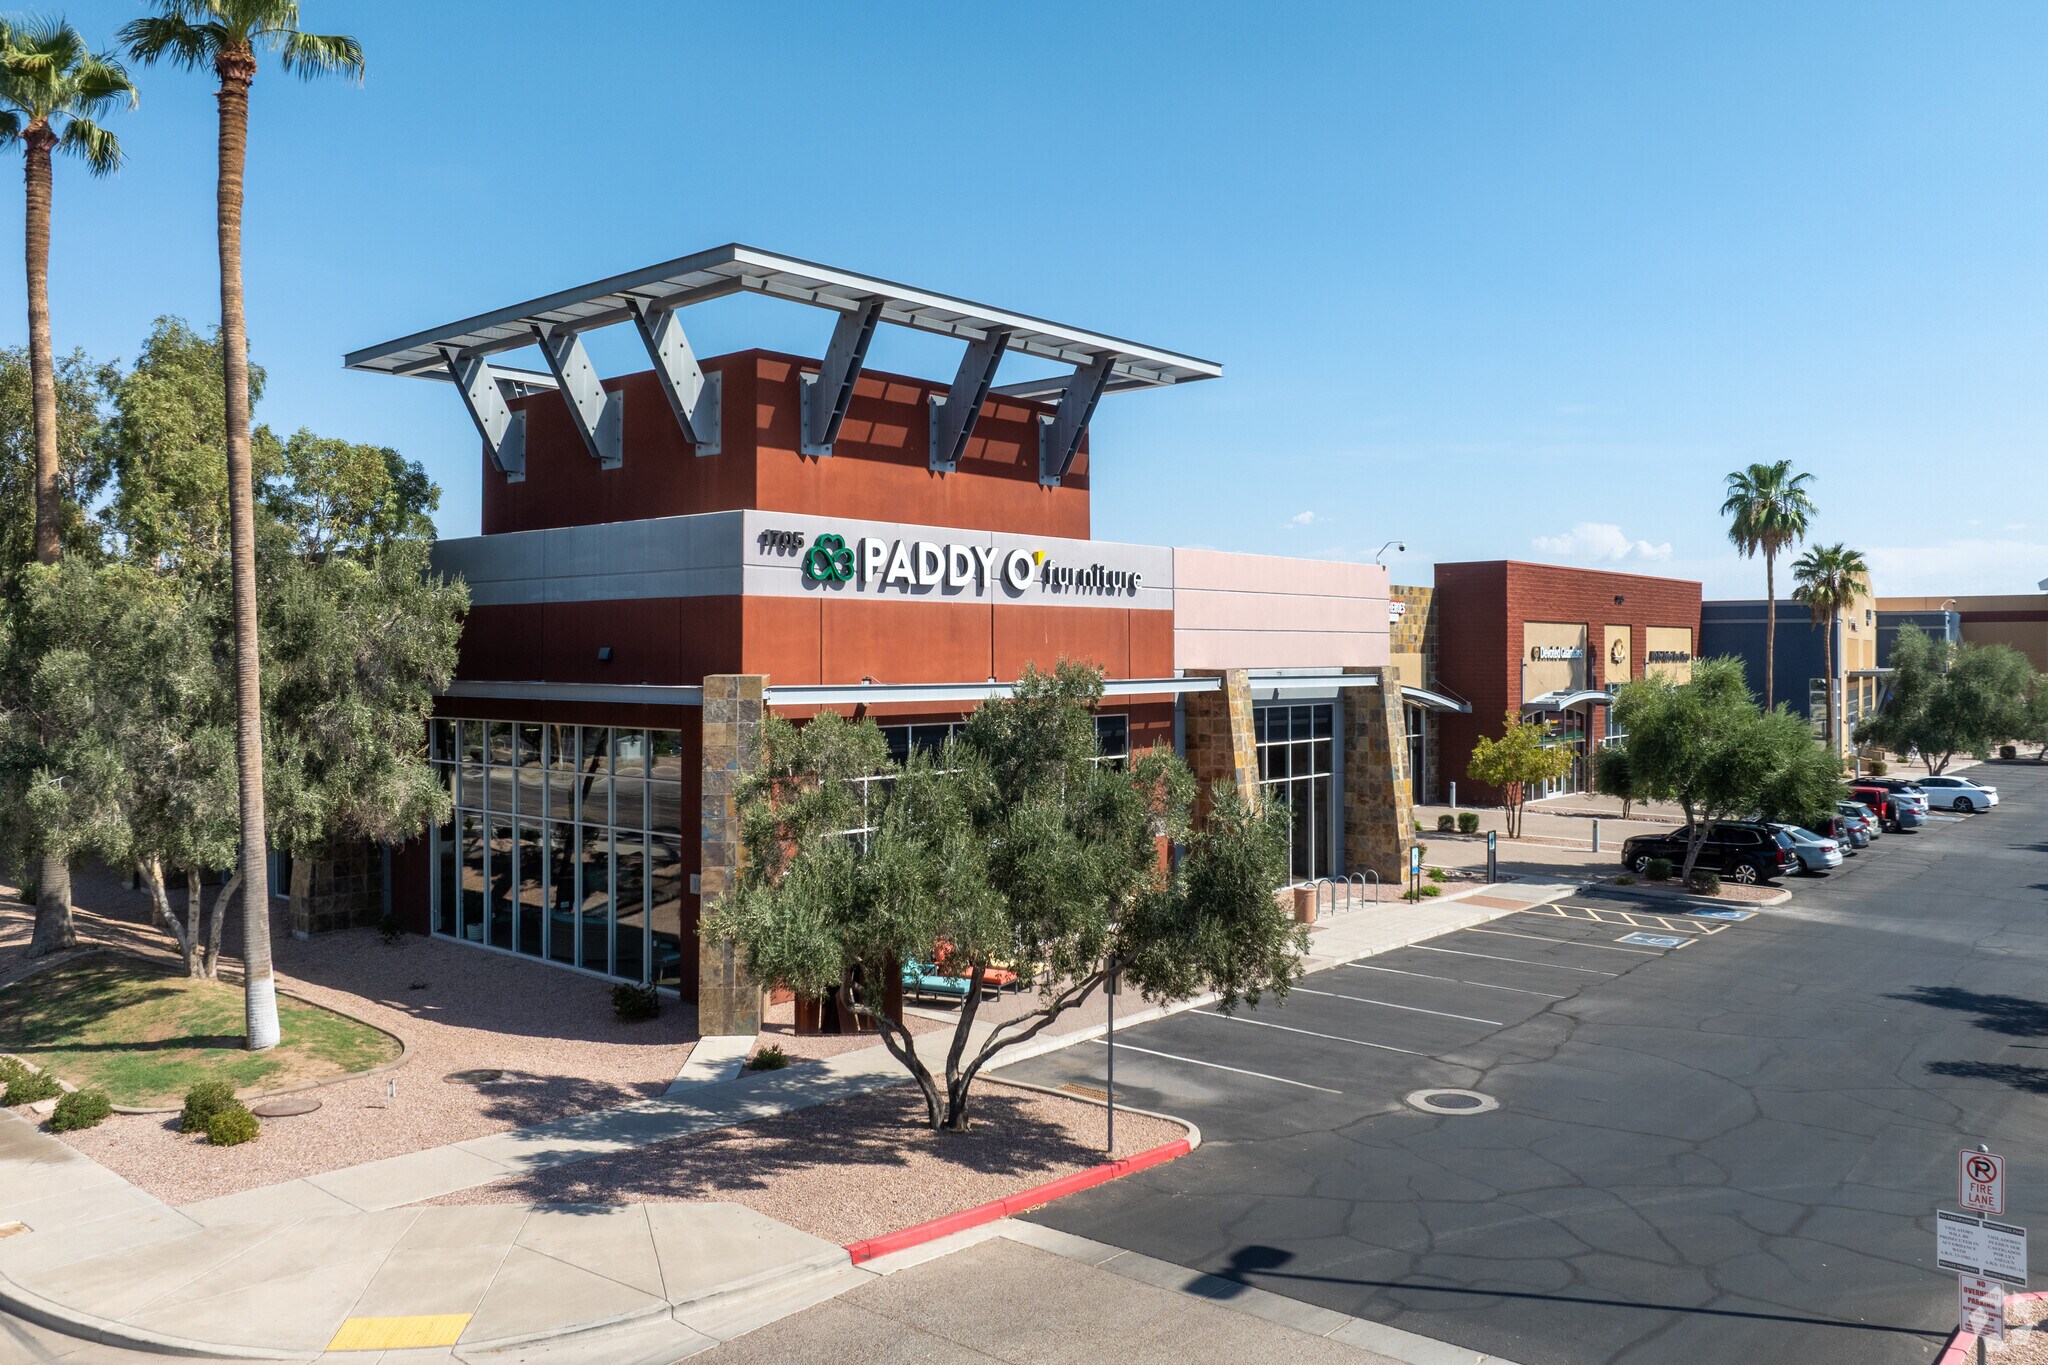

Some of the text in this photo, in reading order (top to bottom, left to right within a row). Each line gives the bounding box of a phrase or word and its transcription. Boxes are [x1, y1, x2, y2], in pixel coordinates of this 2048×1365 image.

[763, 529, 804, 549] 1705
[860, 537, 999, 588] PADDY
[1047, 559, 1144, 590] furniture
[1970, 1182, 1993, 1196] FIRE
[1969, 1192, 1995, 1207] LANE
[1976, 1280, 1986, 1288] NO
